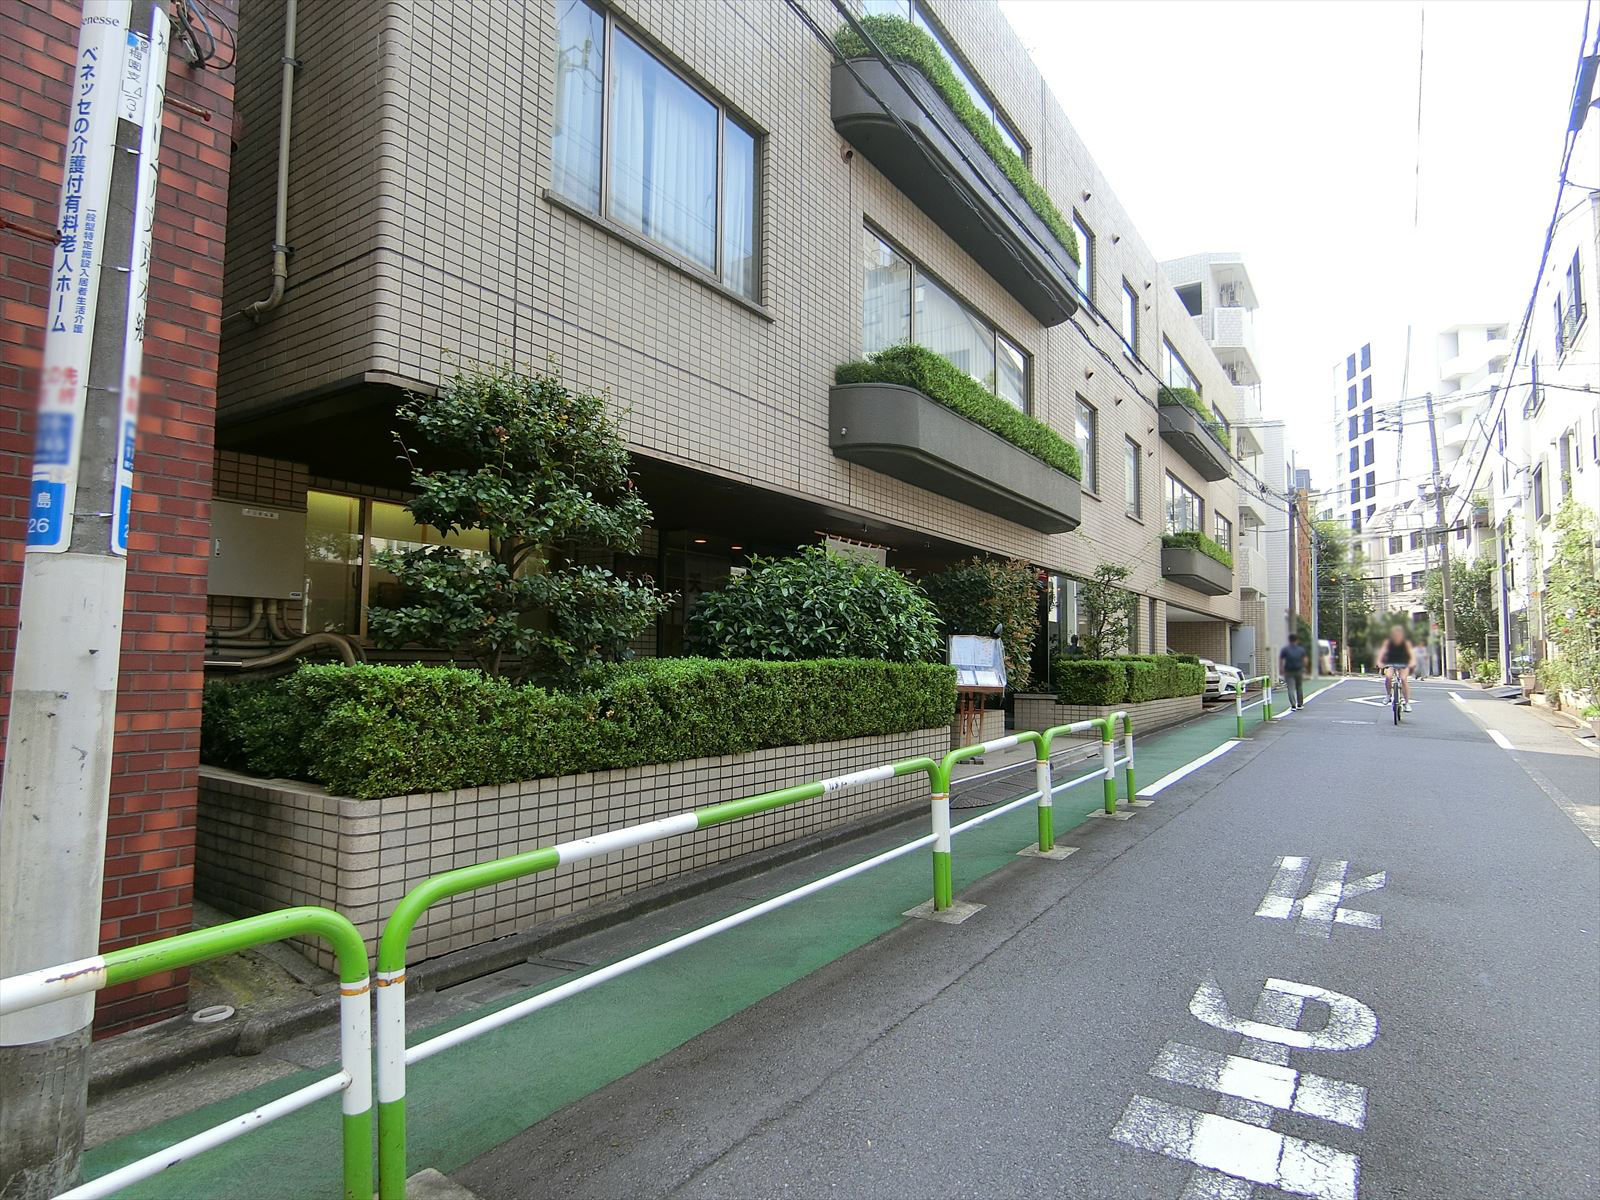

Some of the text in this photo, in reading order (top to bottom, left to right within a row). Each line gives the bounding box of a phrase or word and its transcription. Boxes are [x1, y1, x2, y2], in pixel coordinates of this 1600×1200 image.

[52, 46, 98, 332] ベネッセの介護付有料老人ホーム
